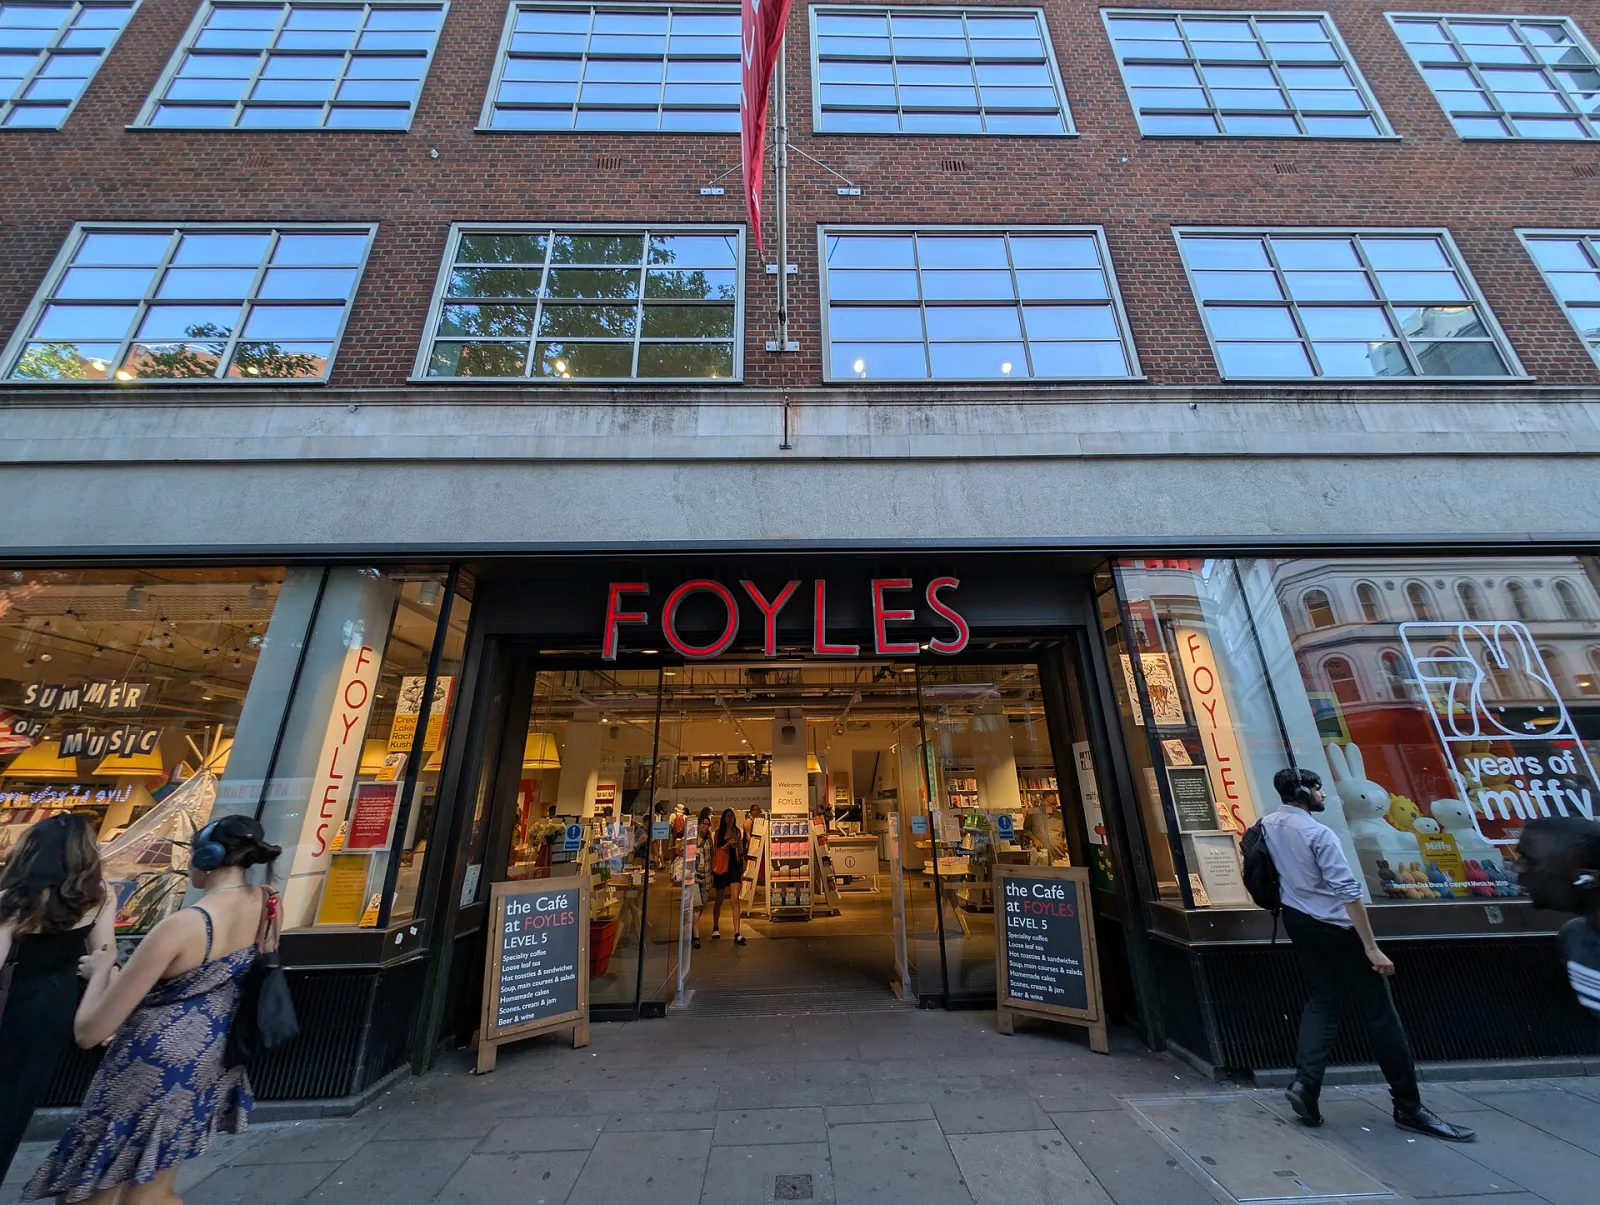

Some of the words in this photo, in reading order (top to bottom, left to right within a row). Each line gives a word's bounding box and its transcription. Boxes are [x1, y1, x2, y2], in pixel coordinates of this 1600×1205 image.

[601, 576, 970, 662] FOYLES
[24, 683, 141, 711] SUMMER
[393, 724, 414, 732] Lake
[395, 716, 435, 724] Crean
[14, 721, 42, 737] OF
[1187, 633, 1247, 837] FOYLES
[62, 730, 157, 756] MUSIC
[311, 645, 373, 858] FOYLES
[1463, 756, 1544, 782] years
[1548, 749, 1577, 774] of
[777, 798, 802, 806] FOYLES
[1477, 779, 1593, 820] miffy
[1424, 841, 1451, 852] Miffy
[1006, 882, 1028, 897] the
[1032, 884, 1065, 899] Café
[507, 900, 530, 915] the
[536, 894, 568, 911] Café
[1007, 901, 1020, 912] at
[1024, 900, 1074, 917] FOYLES
[505, 920, 520, 932] at
[524, 911, 575, 930] FOYLES
[1008, 916, 1038, 929] LEVEL
[1042, 920, 1048, 930] 5
[504, 934, 538, 949] LEVEL
[542, 933, 547, 944] 5
[1008, 932, 1031, 941] Speciality
[503, 952, 529, 962] Speciality
[530, 949, 546, 957] coffee
[1047, 956, 1078, 965] sandwiches
[502, 963, 519, 972] Loose
[521, 961, 531, 969] leaf
[502, 974, 513, 982] Hot
[515, 970, 536, 980] toasties
[543, 964, 573, 975] sandwiches
[1010, 960, 1023, 968] Soup,
[1066, 968, 1082, 976] salads
[1010, 970, 1040, 980] Homemade
[501, 984, 517, 993] Soup,
[517, 981, 531, 990] main
[532, 978, 553, 987] courses
[1010, 980, 1030, 989] Scones,
[500, 992, 533, 1004] Homemade
[535, 988, 550, 996] cakes
[499, 1004, 521, 1015] Scones,
[522, 1001, 540, 1009] cream
[546, 997, 557, 1006] jam
[498, 1016, 513, 1026] Beer
